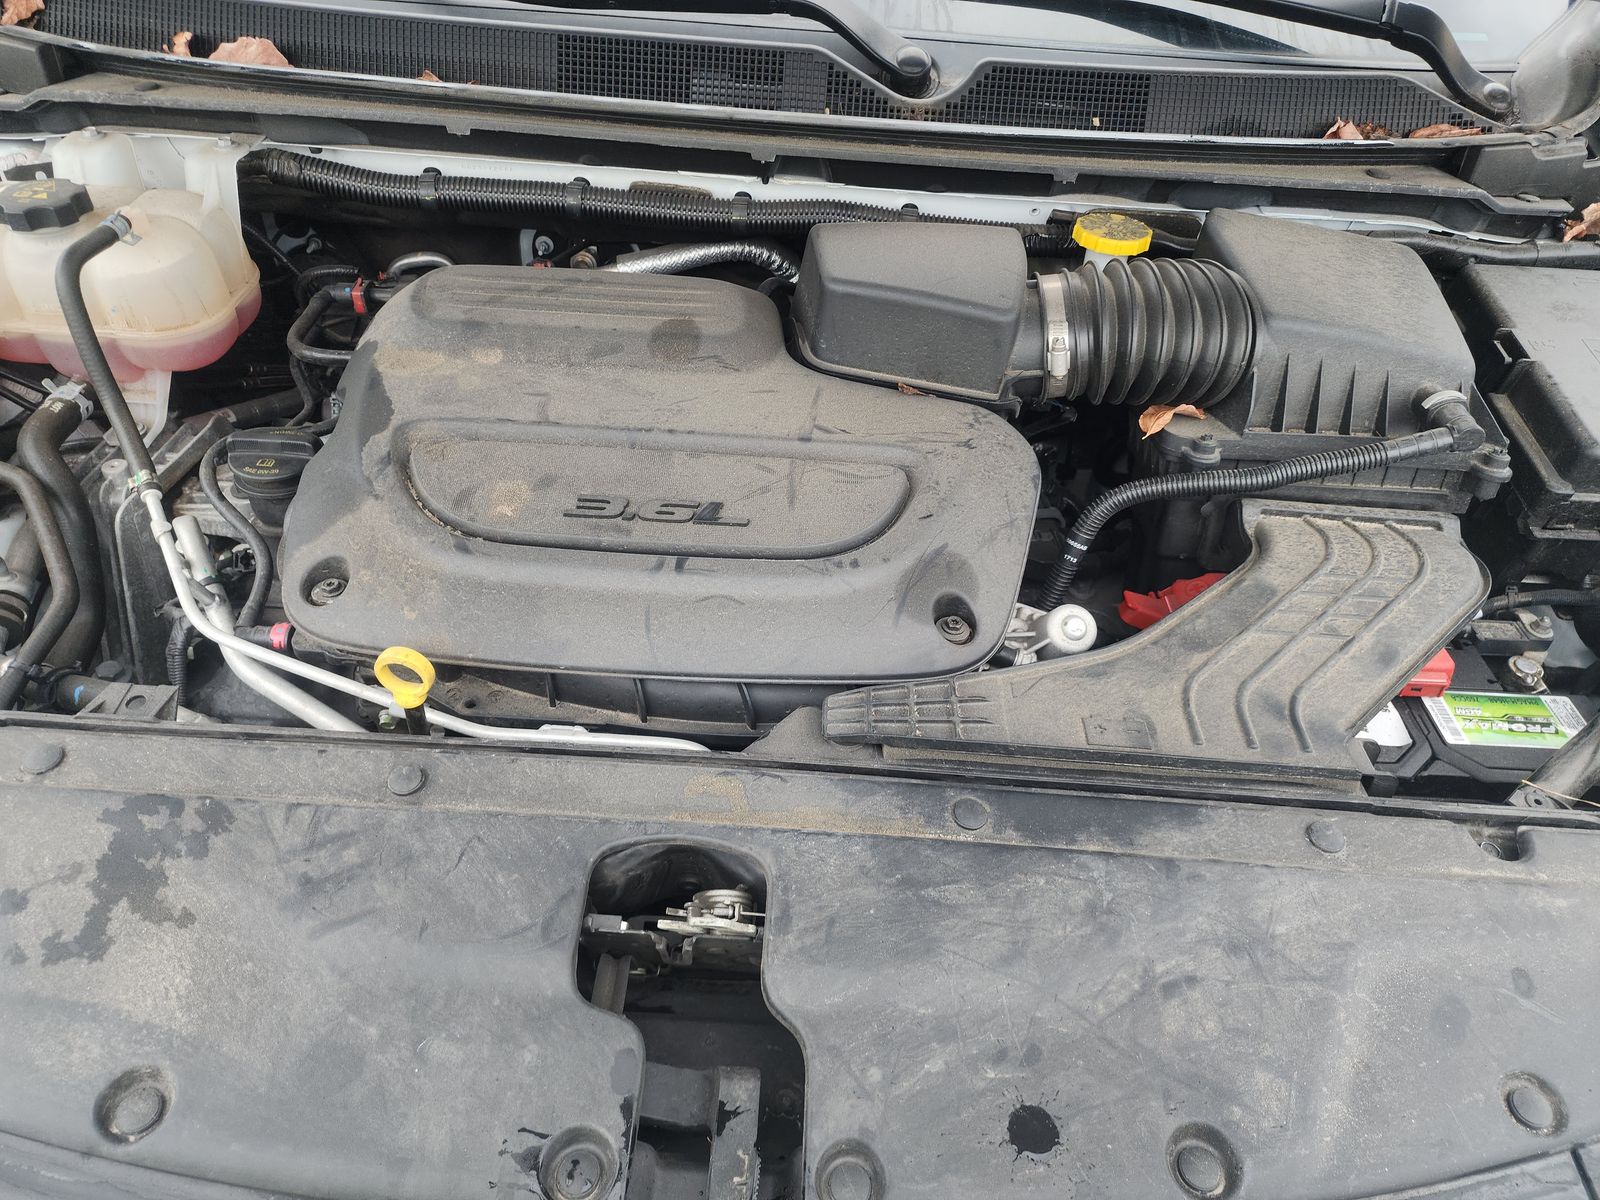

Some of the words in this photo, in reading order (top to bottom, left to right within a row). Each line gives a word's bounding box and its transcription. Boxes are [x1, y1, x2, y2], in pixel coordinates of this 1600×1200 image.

[563, 494, 750, 528] 3.6L
[1456, 707, 1482, 716] AGM
[1462, 717, 1557, 734] PROMAX
